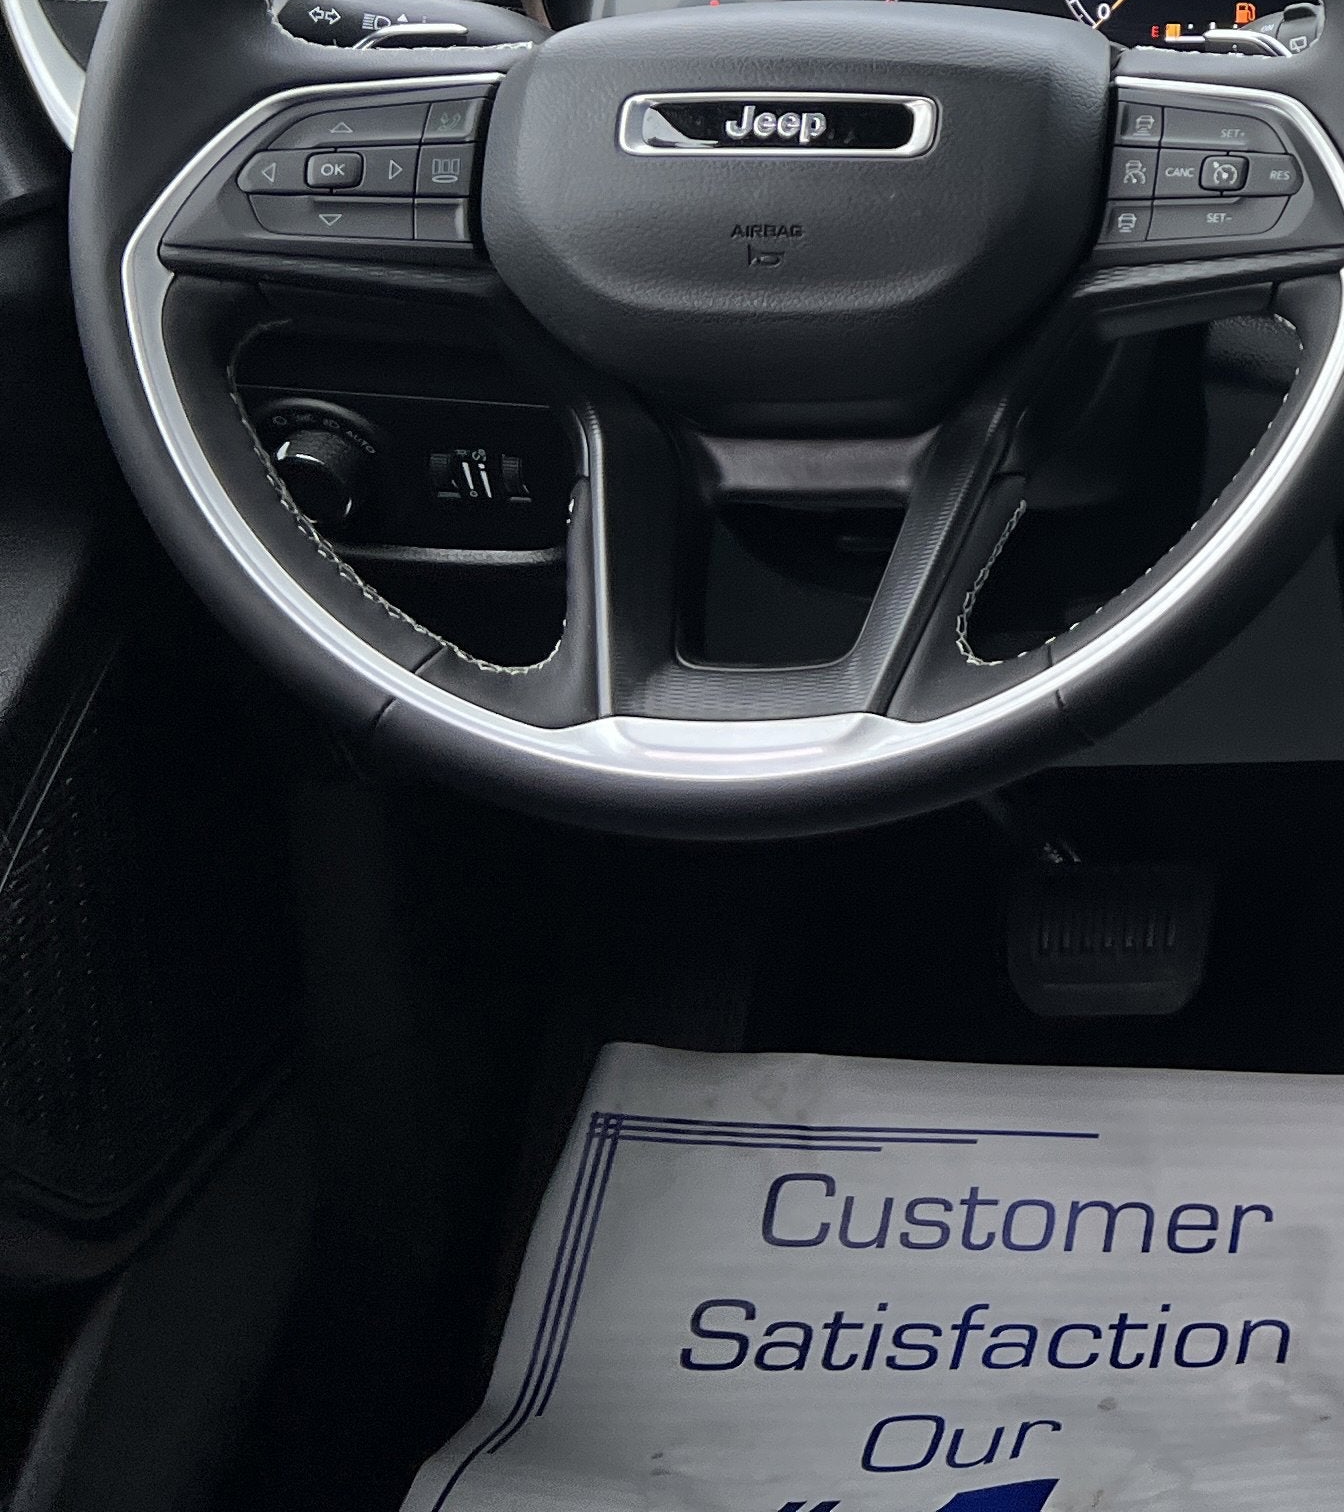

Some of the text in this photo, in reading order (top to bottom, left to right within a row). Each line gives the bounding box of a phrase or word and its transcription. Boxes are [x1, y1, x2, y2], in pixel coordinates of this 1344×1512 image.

[1097, 4, 1111, 20] 0
[1151, 25, 1160, 38] E
[725, 105, 827, 143] Jeep
[321, 163, 345, 176] OK
[1165, 168, 1195, 178] CANC
[1269, 170, 1291, 181] RES
[731, 224, 803, 239] AIRBAG
[346, 430, 377, 455] AUTO
[761, 1172, 1273, 1256] Customer
[679, 1299, 1292, 1372] Satisfaction
[861, 1414, 1063, 1473] Our
